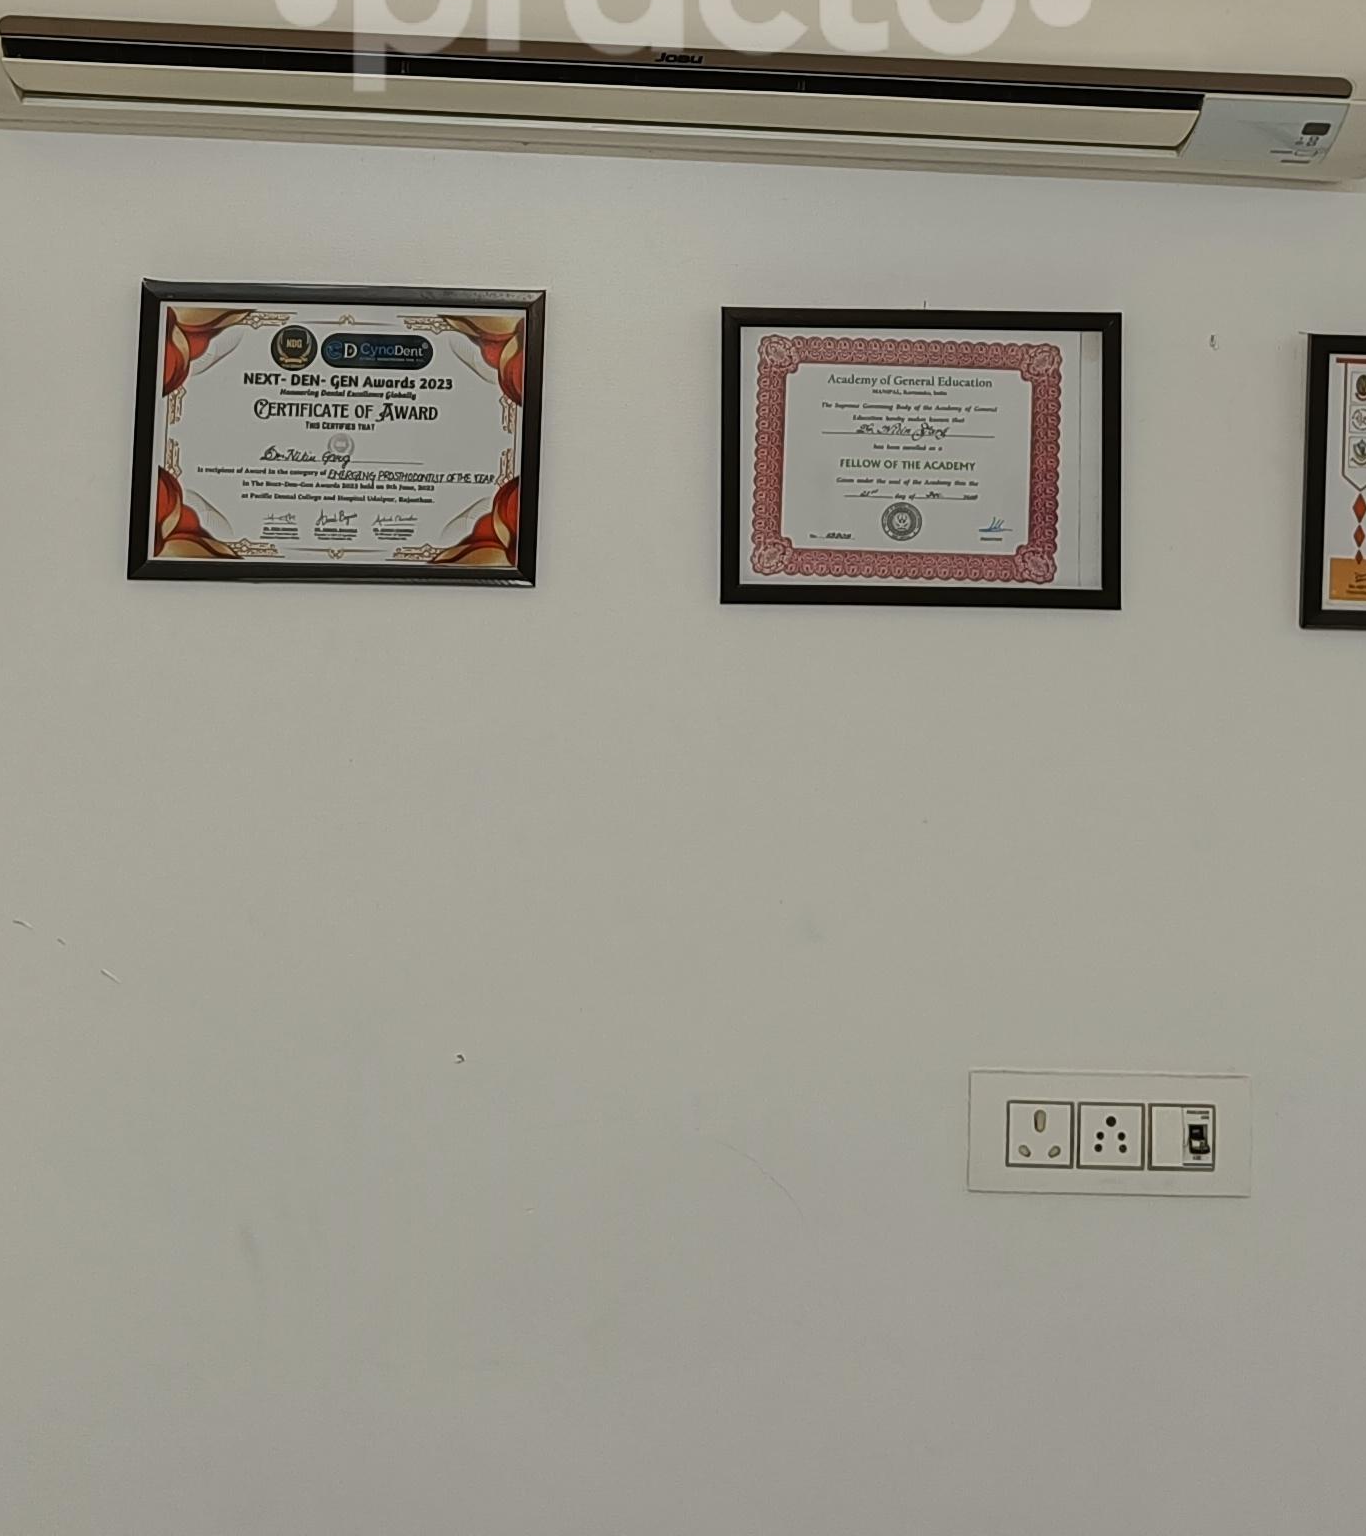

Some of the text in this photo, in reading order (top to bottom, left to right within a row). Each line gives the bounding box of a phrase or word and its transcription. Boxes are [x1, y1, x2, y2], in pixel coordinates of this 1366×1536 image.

[244, 373, 453, 390] NEXT- DEN- GEN Awards 2023
[828, 374, 992, 388] Academy of General Education
[840, 459, 976, 471] FELLOW OF THE ACADEMY
[328, 469, 376, 484] EMERGING
